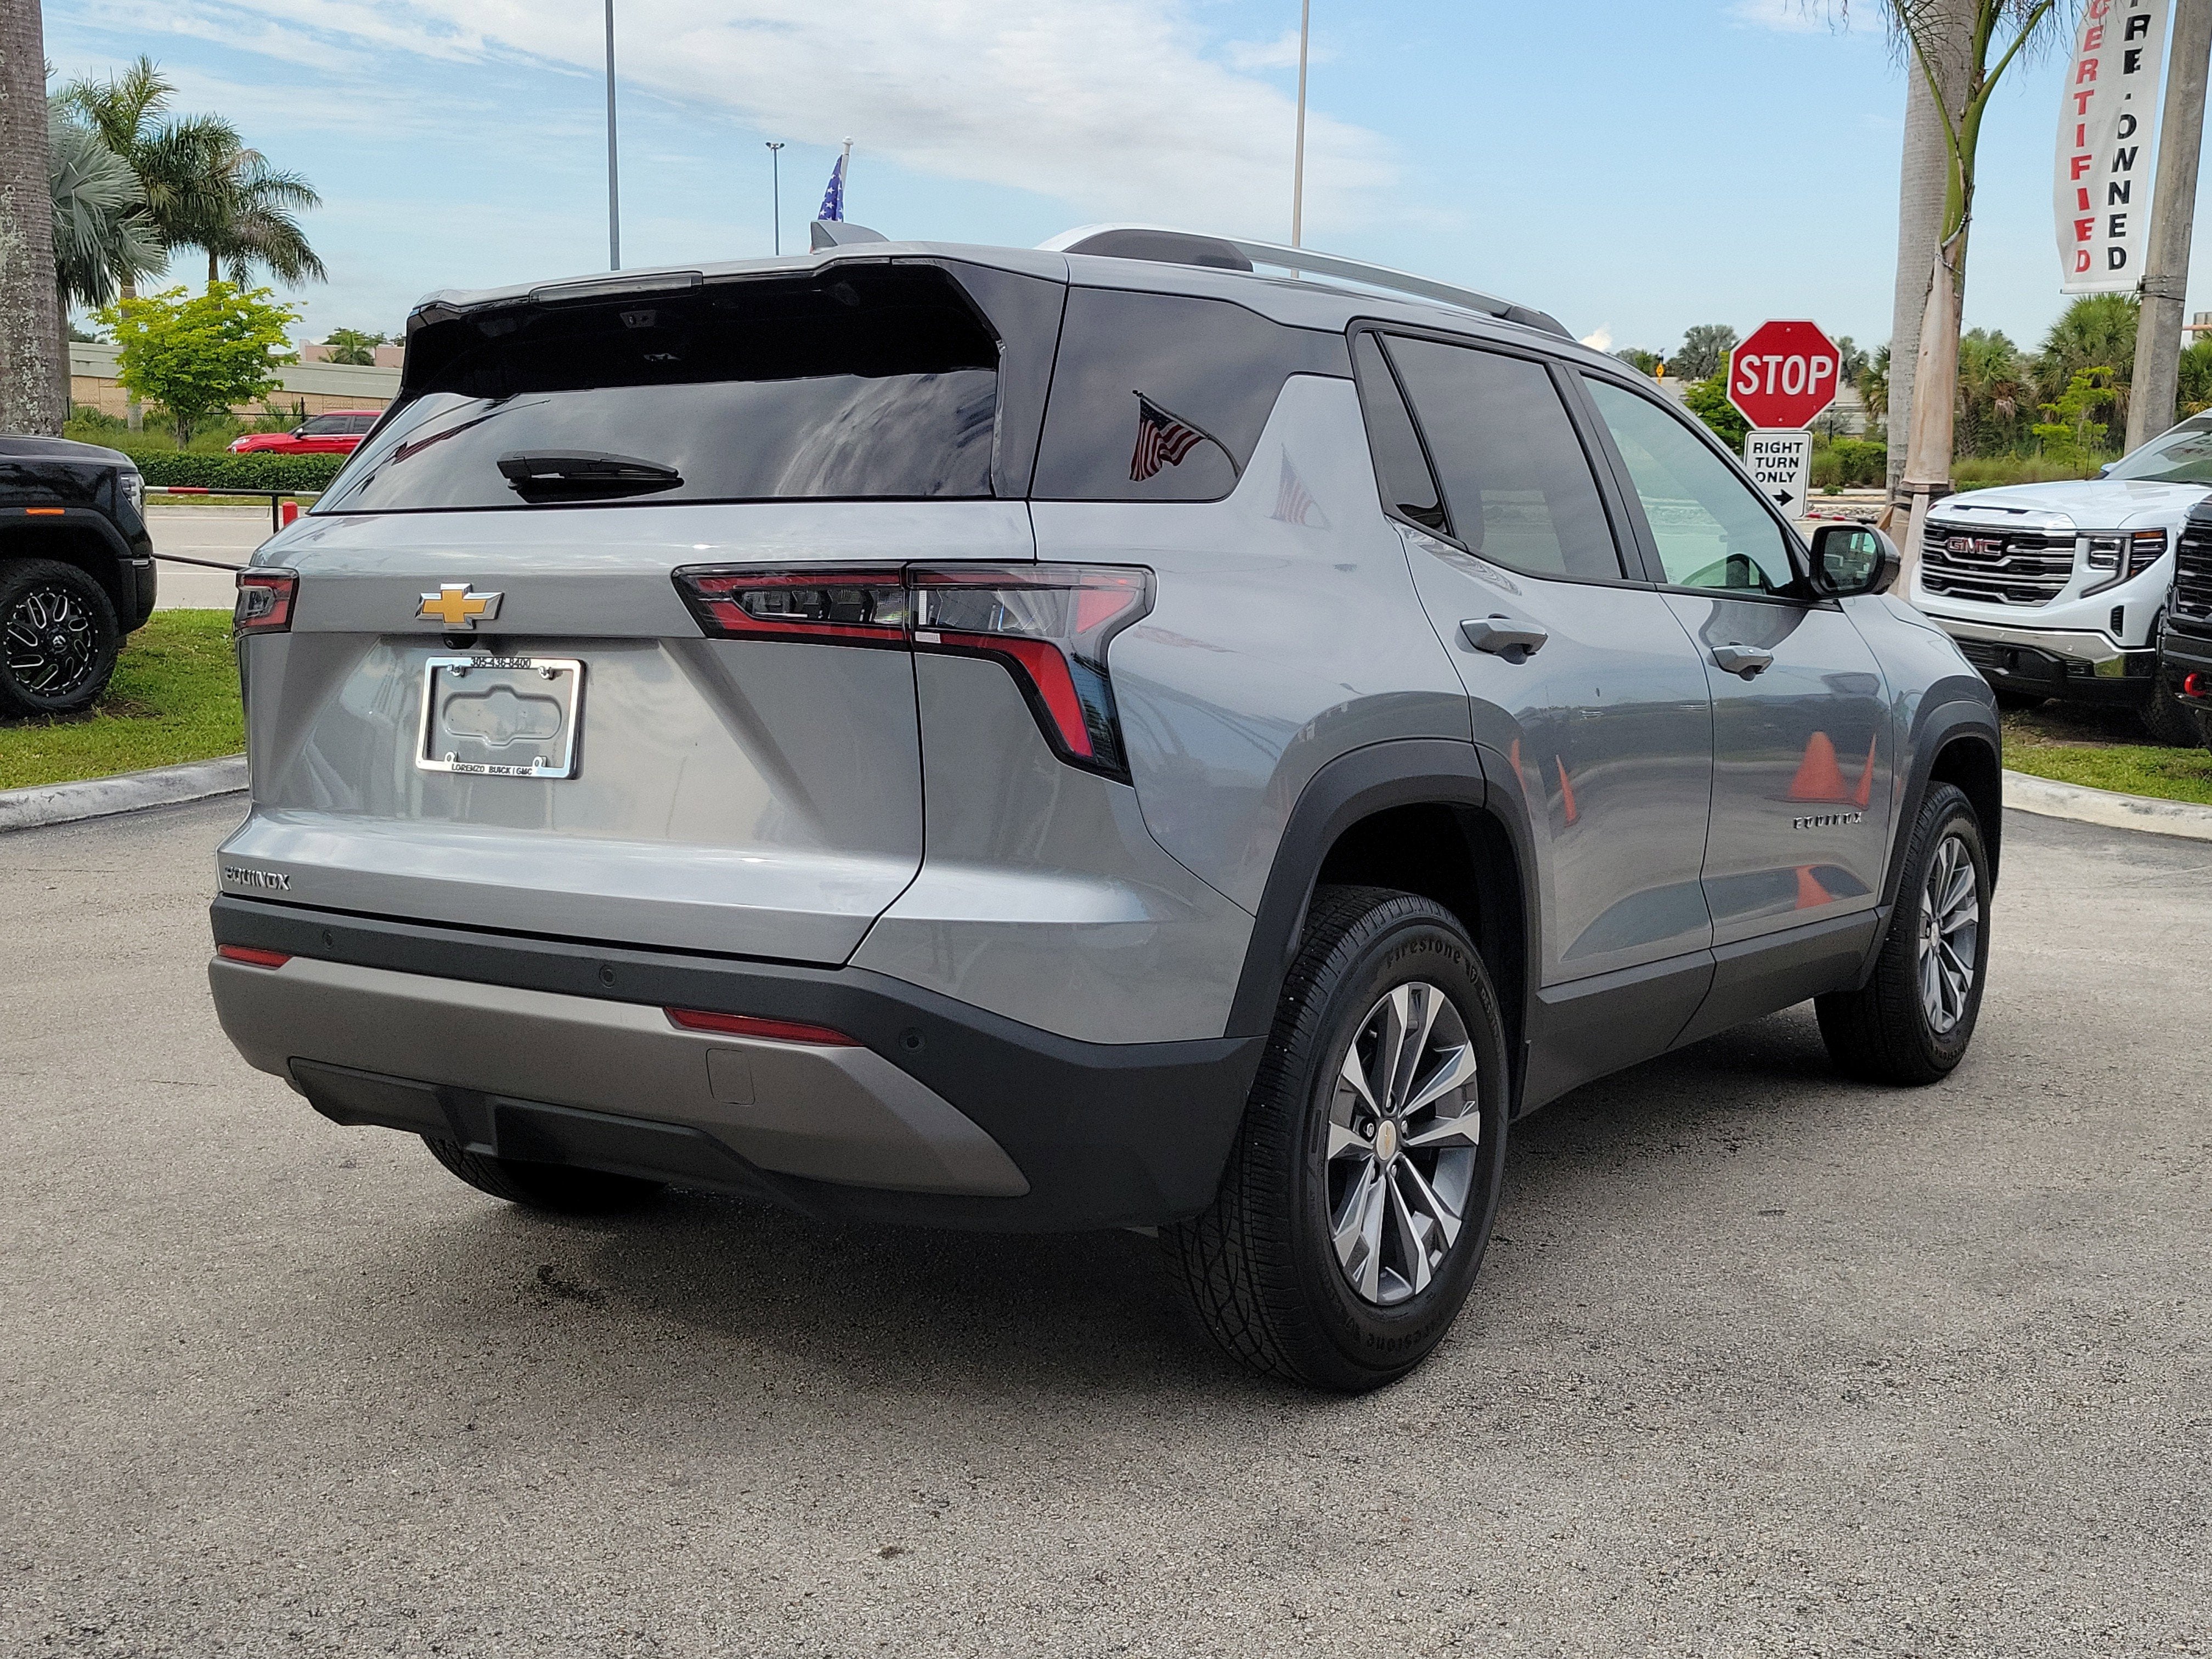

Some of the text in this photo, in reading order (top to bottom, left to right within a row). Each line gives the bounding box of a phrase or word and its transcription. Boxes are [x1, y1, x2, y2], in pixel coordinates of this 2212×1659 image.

[2070, 0, 2111, 272] CERTIFIED
[2108, 0, 2151, 270] RE-OWNED
[1736, 355, 1833, 396] STOP
[1753, 442, 1803, 454] RIGHT
[1756, 457, 1799, 468] TURN
[1756, 471, 1797, 483] ONLY
[1947, 537, 2002, 556] GMC
[471, 657, 531, 669] 305-436-8400
[452, 763, 485, 772] LORENZO
[489, 766, 510, 774] BUICK
[1793, 812, 1862, 829] EQUINOX
[224, 865, 292, 891] EQUINOX
[1385, 937, 1460, 968] Firestone
